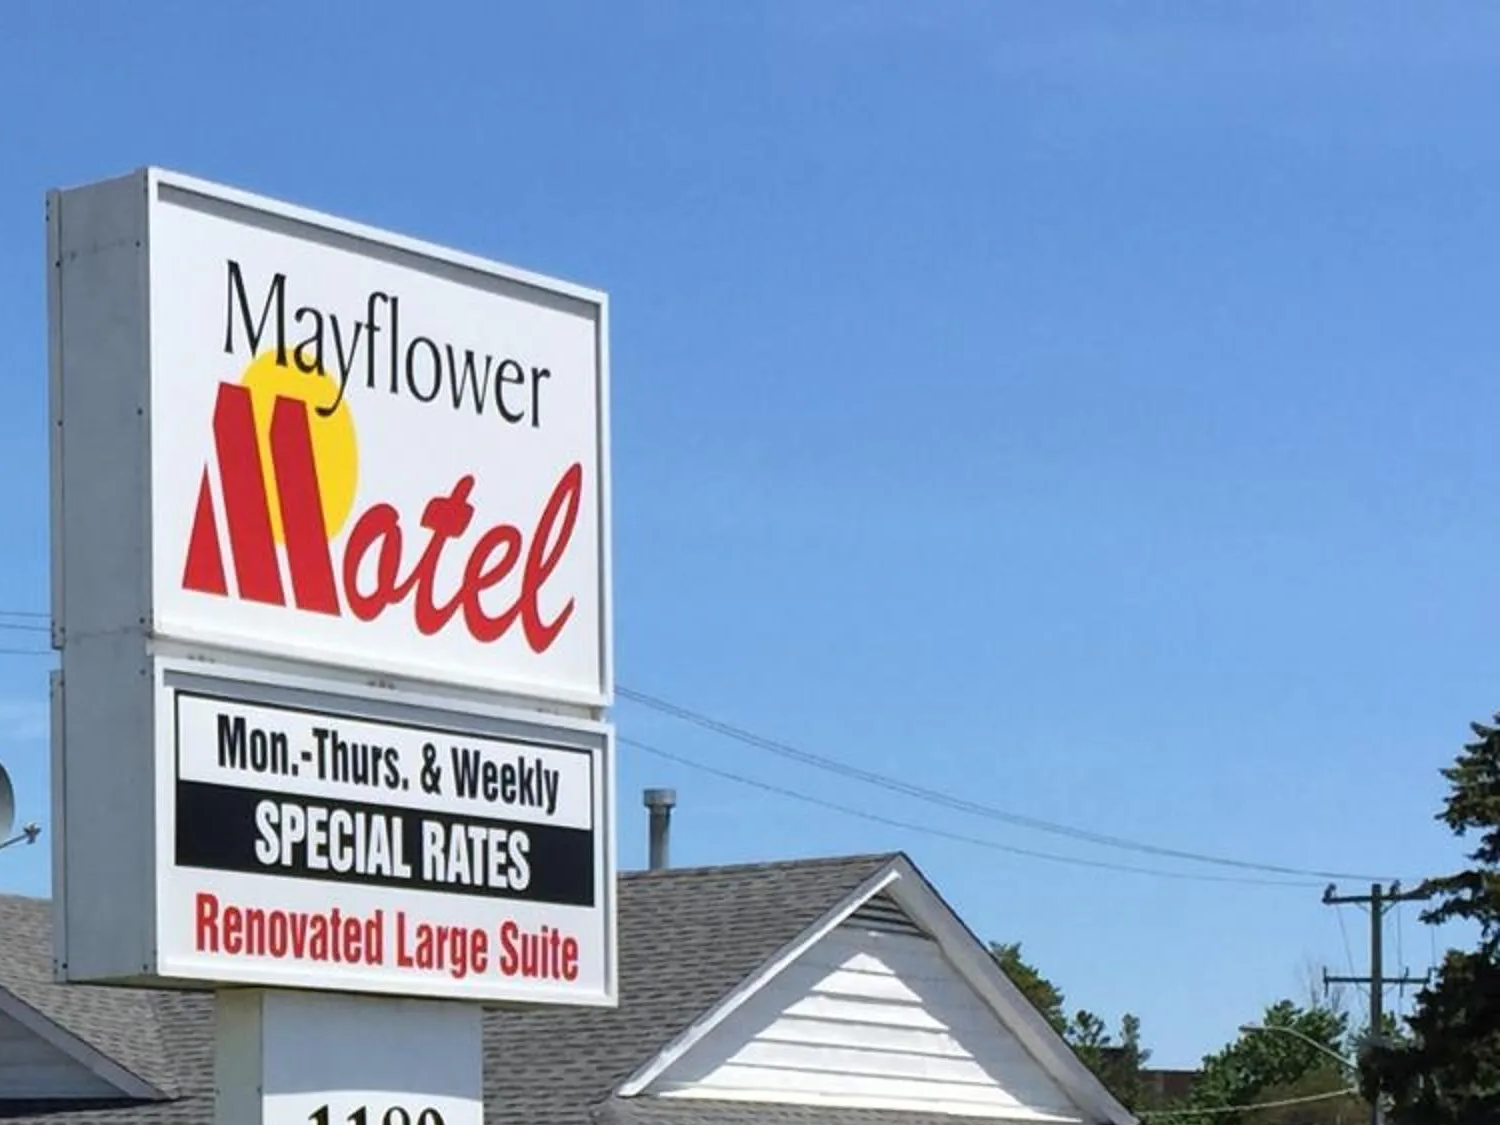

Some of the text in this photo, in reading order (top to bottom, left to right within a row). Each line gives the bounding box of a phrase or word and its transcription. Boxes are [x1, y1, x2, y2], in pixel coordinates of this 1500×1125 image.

[224, 259, 551, 428] Mayflower
[182, 380, 583, 655] Motel
[217, 713, 560, 816] Mon.-Thurs. & Weekly
[254, 800, 532, 892] SPECIAL RATES
[195, 892, 579, 982] Renovated Large Suite
